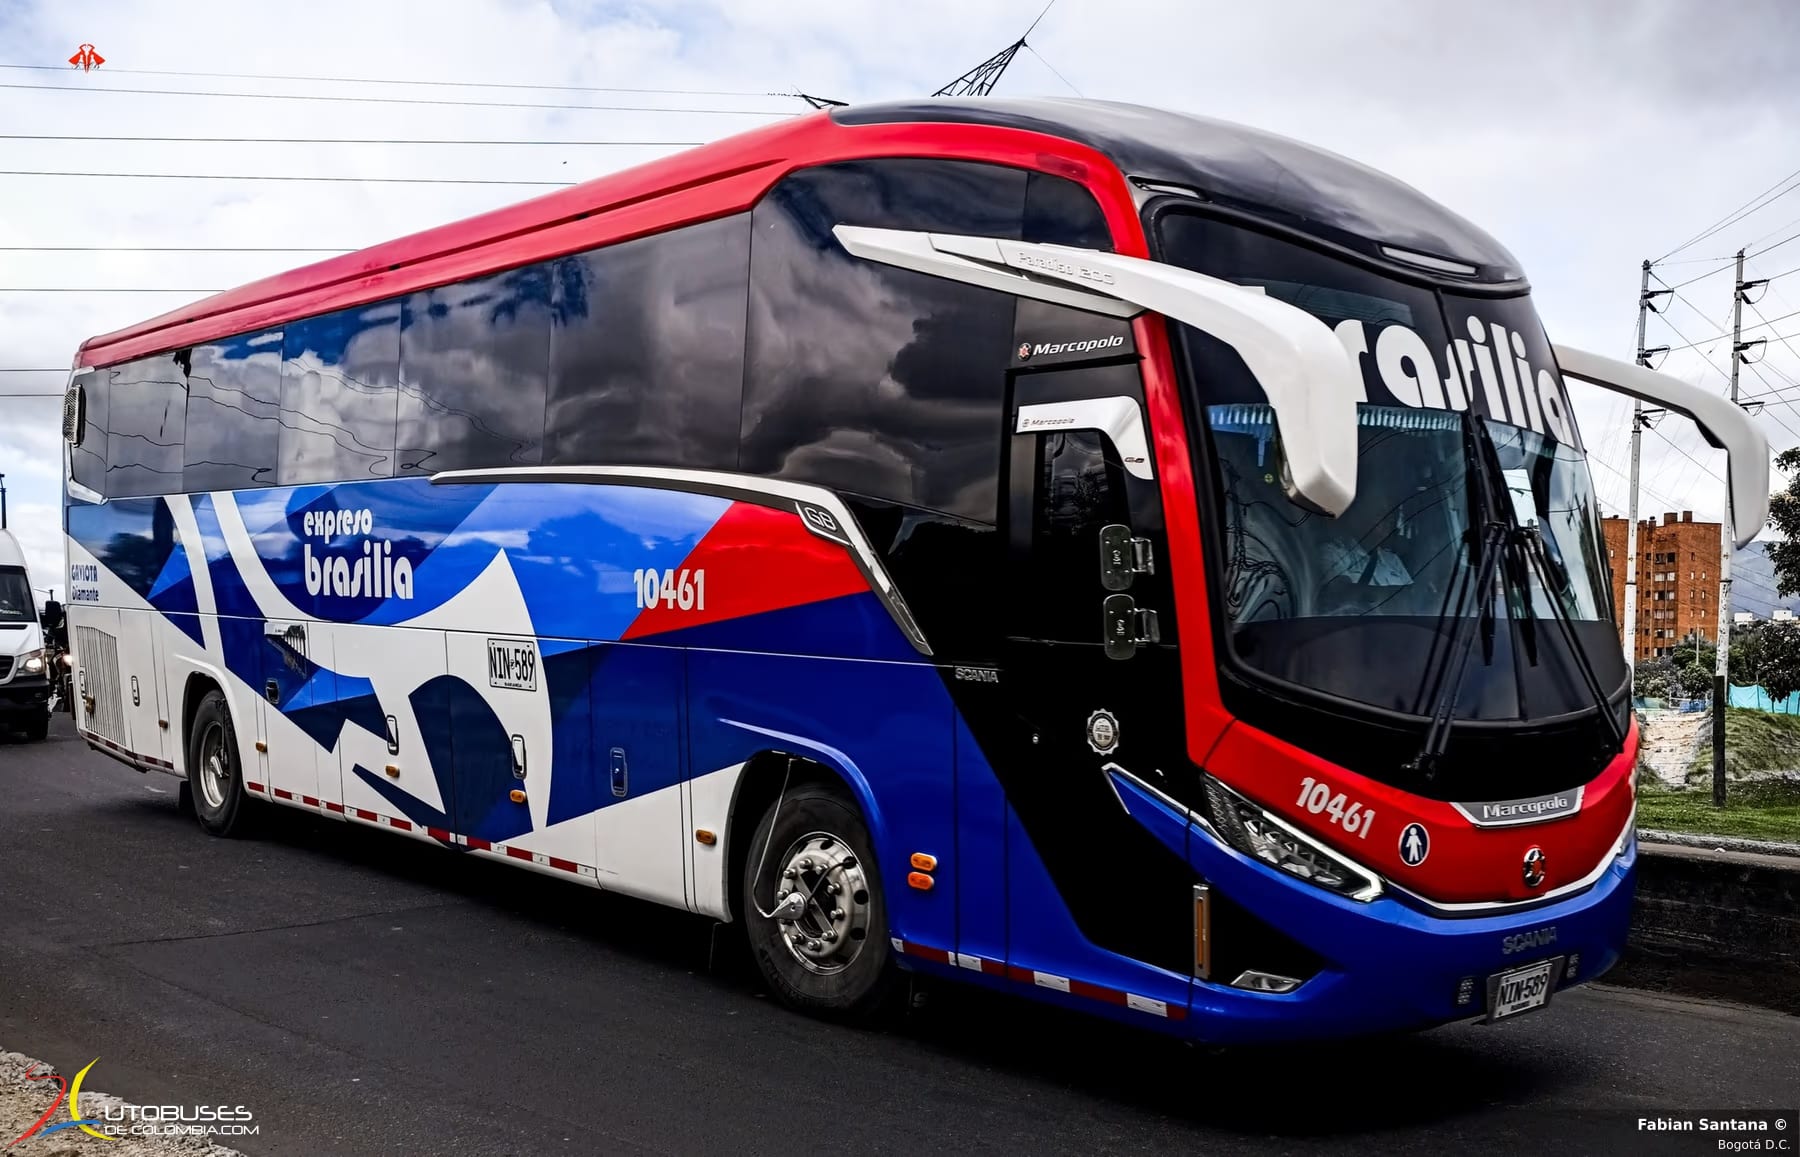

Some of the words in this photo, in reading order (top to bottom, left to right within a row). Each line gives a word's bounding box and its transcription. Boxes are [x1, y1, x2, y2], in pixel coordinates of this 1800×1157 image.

[1033, 335, 1124, 356] Marcopolo
[1240, 286, 1575, 449] rasilia
[303, 508, 373, 545] expreso
[71, 564, 98, 582] GAVIOTA
[303, 539, 414, 600] brasilia
[71, 585, 99, 601] Diamante
[633, 568, 705, 611] 10461
[955, 667, 999, 683] SCANIA
[1296, 776, 1376, 839] 10461
[1483, 796, 1568, 819] Marcopolo
[1502, 926, 1558, 955] SCANIA
